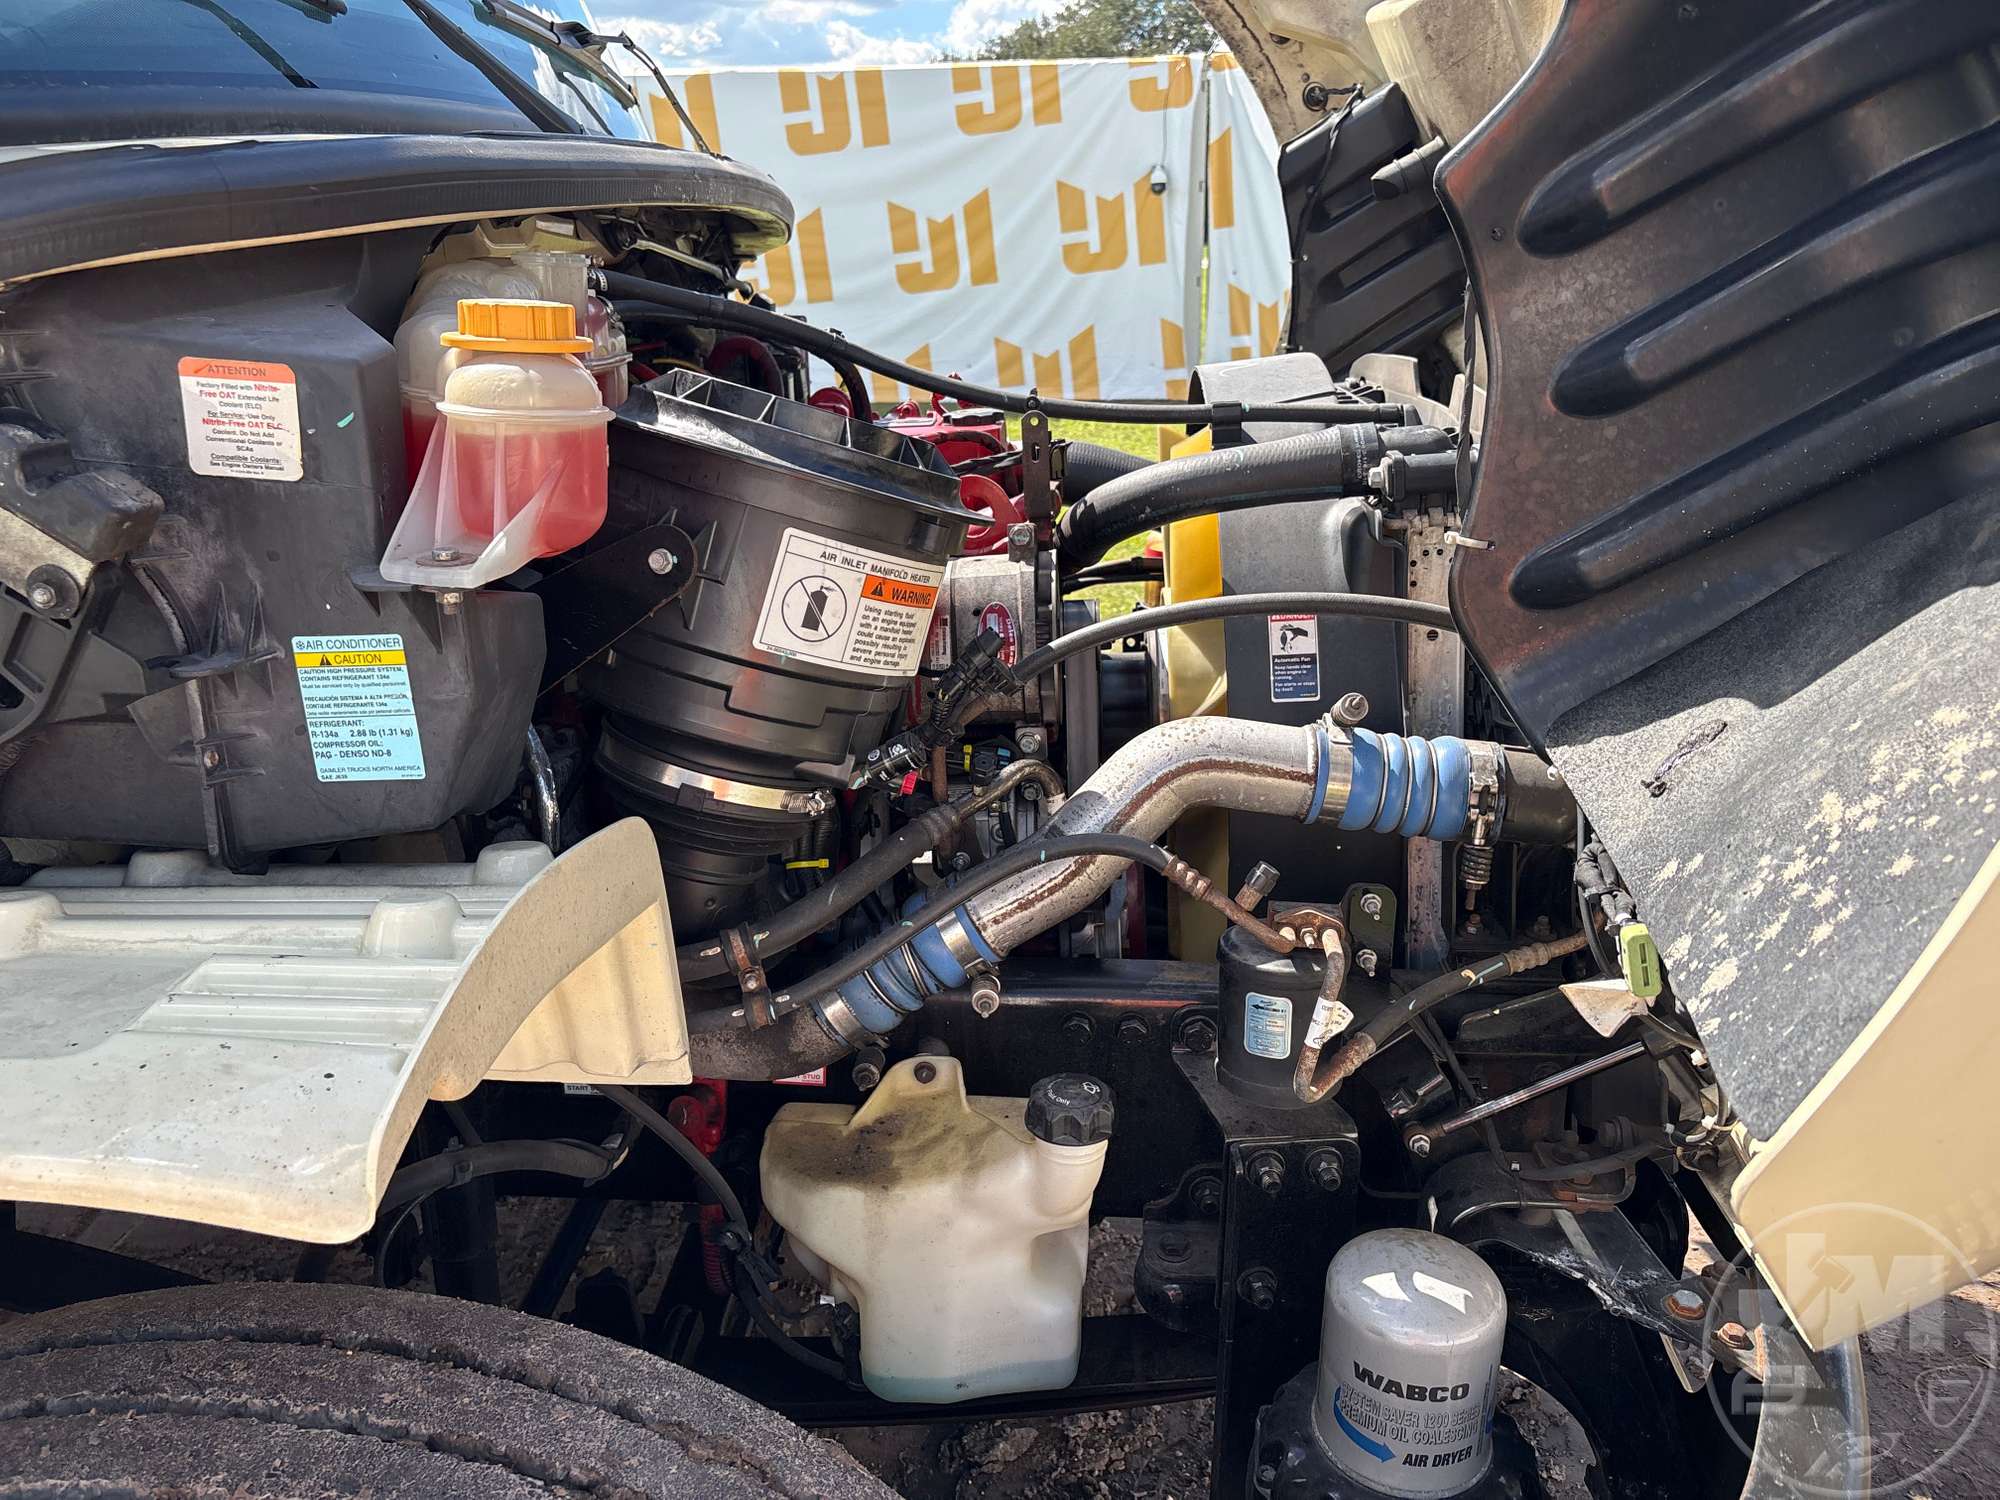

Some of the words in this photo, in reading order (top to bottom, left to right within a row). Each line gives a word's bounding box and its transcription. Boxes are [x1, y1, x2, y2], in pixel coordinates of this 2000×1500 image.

[208, 365, 266, 377] ATTENTION
[196, 381, 220, 390] Factory
[254, 384, 280, 392] Nitrite-
[200, 390, 217, 398] Free
[219, 391, 236, 399] OAT
[202, 418, 245, 428] Nitrite-Free
[248, 421, 265, 429] OAT
[210, 452, 249, 461] Compatible
[820, 551, 838, 562] AIR
[841, 556, 868, 571] INLET
[870, 564, 909, 580] MANIFOLD
[910, 572, 931, 583] HEATER
[892, 587, 932, 606] WARNING
[864, 604, 882, 616] Using
[856, 630, 874, 639] could
[306, 639, 324, 650] AIR
[326, 637, 401, 650] CONDITIONER
[854, 638, 880, 649] possibly
[333, 653, 382, 665] CAUTION
[305, 702, 332, 710] CONTIENE
[309, 719, 365, 728] REFRIGERANT:
[311, 729, 339, 739] R-134a
[350, 728, 367, 738] 2.88
[368, 728, 378, 737] lb
[379, 727, 398, 738] (1.31
[399, 727, 414, 737] kg)
[313, 740, 367, 749] COMPRESSOR
[368, 739, 384, 747] OIL:
[314, 751, 333, 759] PAG
[339, 750, 370, 759] DENSO
[371, 749, 392, 757] ND-8
[1353, 1360, 1470, 1403] WABCO
[1341, 1381, 1382, 1418] SYSTEM
[1383, 1405, 1420, 1428] SAVER
[1423, 1411, 1450, 1429] 1200
[1451, 1405, 1481, 1427] SERIES
[1340, 1397, 1388, 1438] PREMIUM
[1390, 1423, 1410, 1444] OIL
[1412, 1420, 1479, 1446] COALESCING
[1402, 1453, 1430, 1468] AIR
[1431, 1445, 1473, 1468] DRYER
